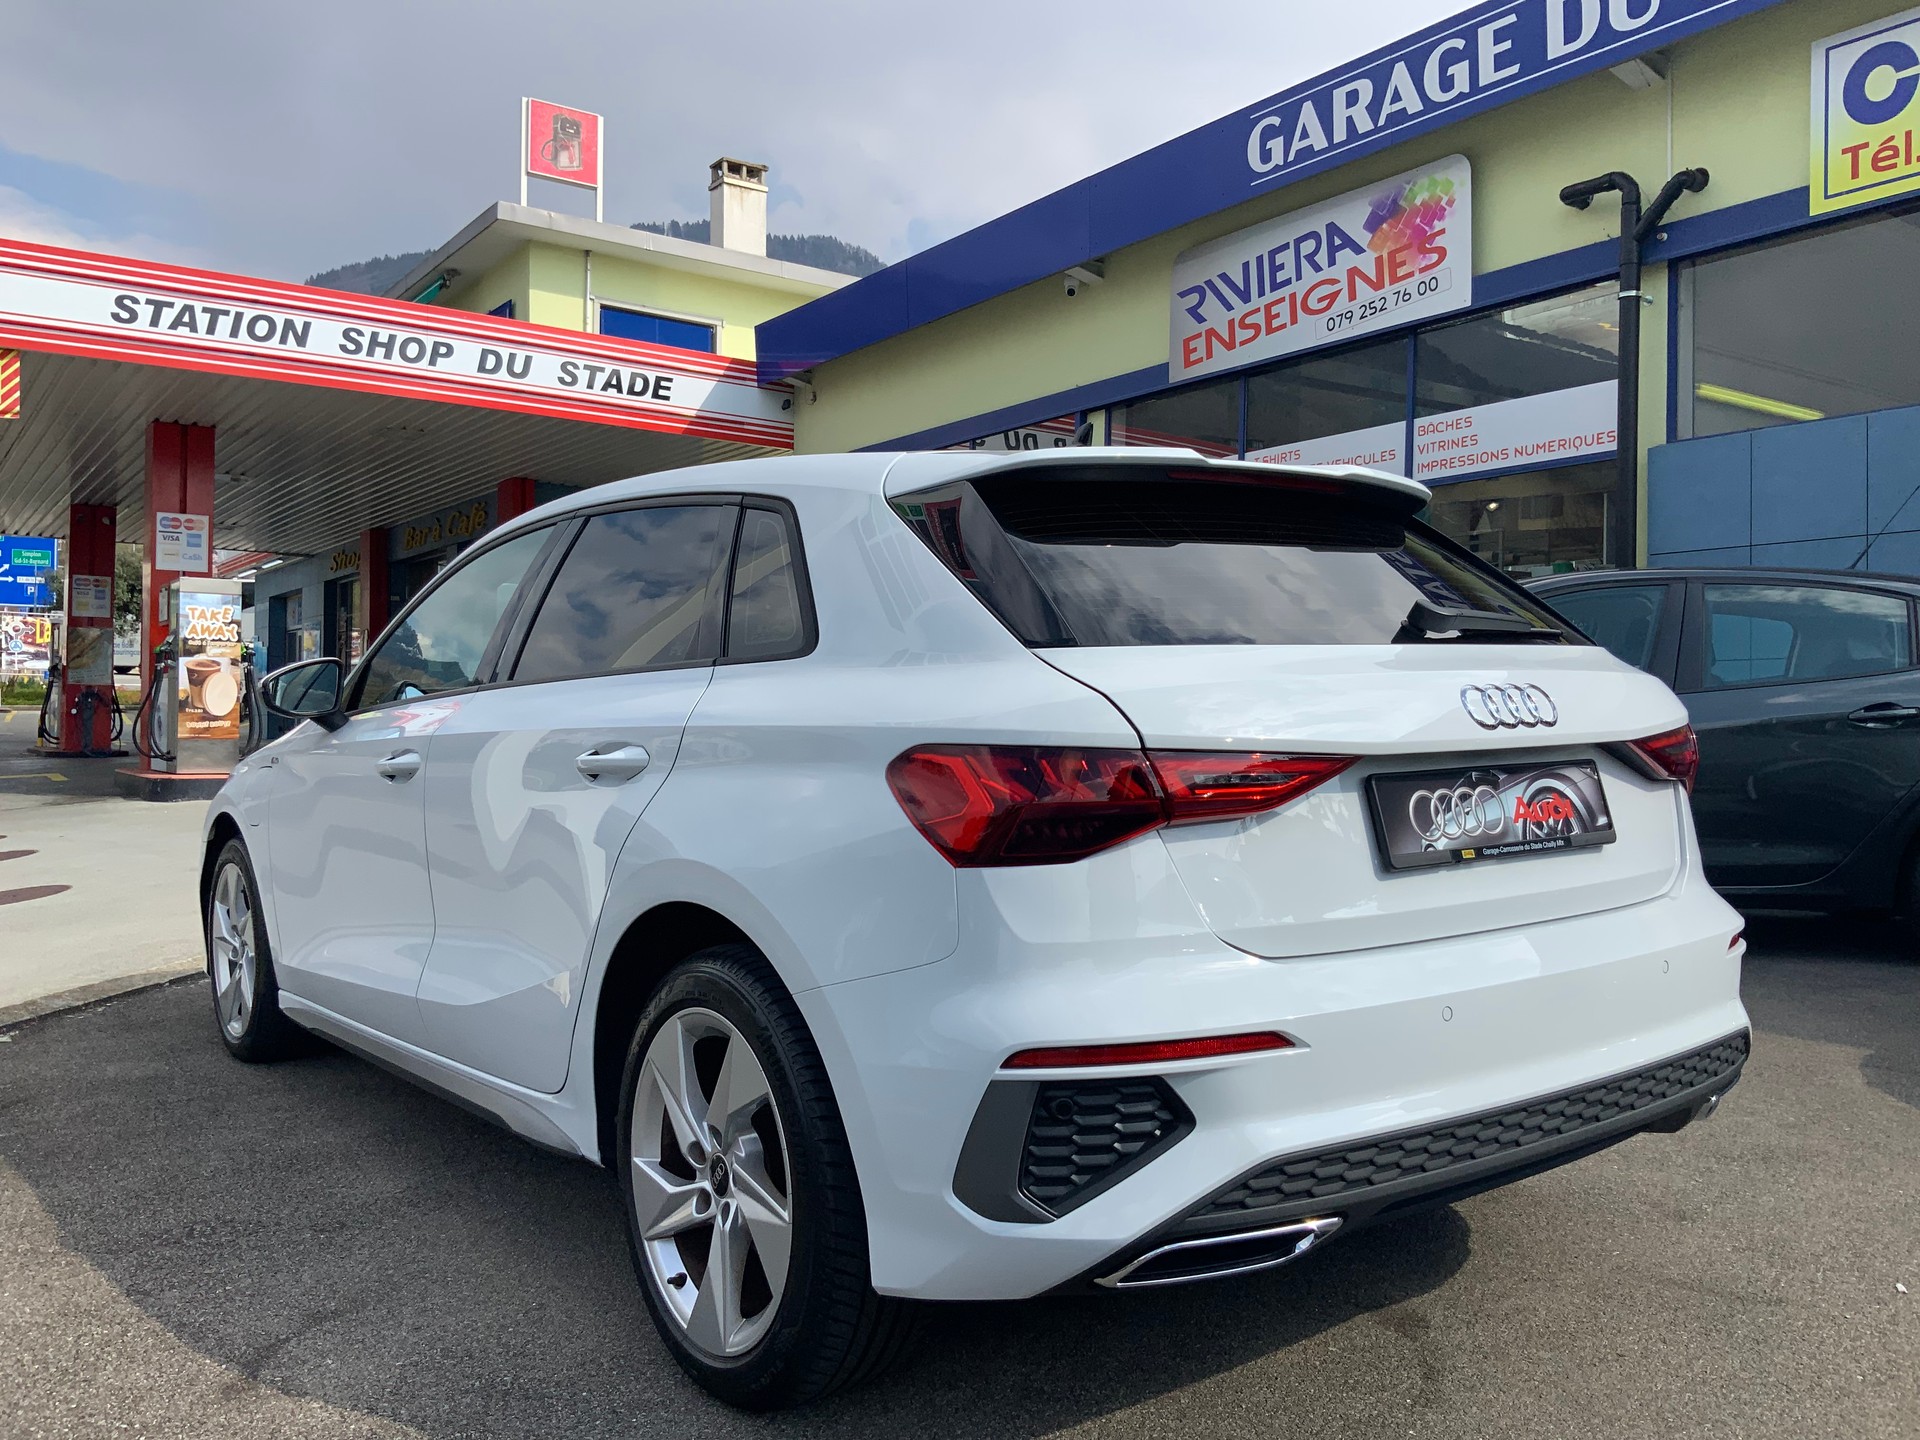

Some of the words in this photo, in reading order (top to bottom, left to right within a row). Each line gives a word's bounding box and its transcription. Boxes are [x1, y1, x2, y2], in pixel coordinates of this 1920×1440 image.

[1247, 13, 1521, 173] GARAGE
[1177, 221, 1366, 325] RIVIERA
[1182, 228, 1448, 369] ENSEIGNES
[1326, 310, 1354, 332] 079
[1359, 297, 1387, 320] 252
[1394, 287, 1412, 308] 76
[1417, 276, 1439, 296] 00
[110, 294, 312, 348] STATION
[339, 326, 454, 367] SHOP
[476, 348, 533, 380] DU
[557, 361, 674, 401] STADE
[1417, 434, 1478, 455] VITRINES
[1417, 448, 1510, 474] IMPRESSIONS
[1514, 430, 1617, 458] NUMERIQUES
[405, 526, 431, 549] Bar
[447, 501, 487, 537] Café
[187, 606, 232, 622] TAKE
[187, 623, 237, 640] AWAY
[1530, 842, 1542, 850] Stade
